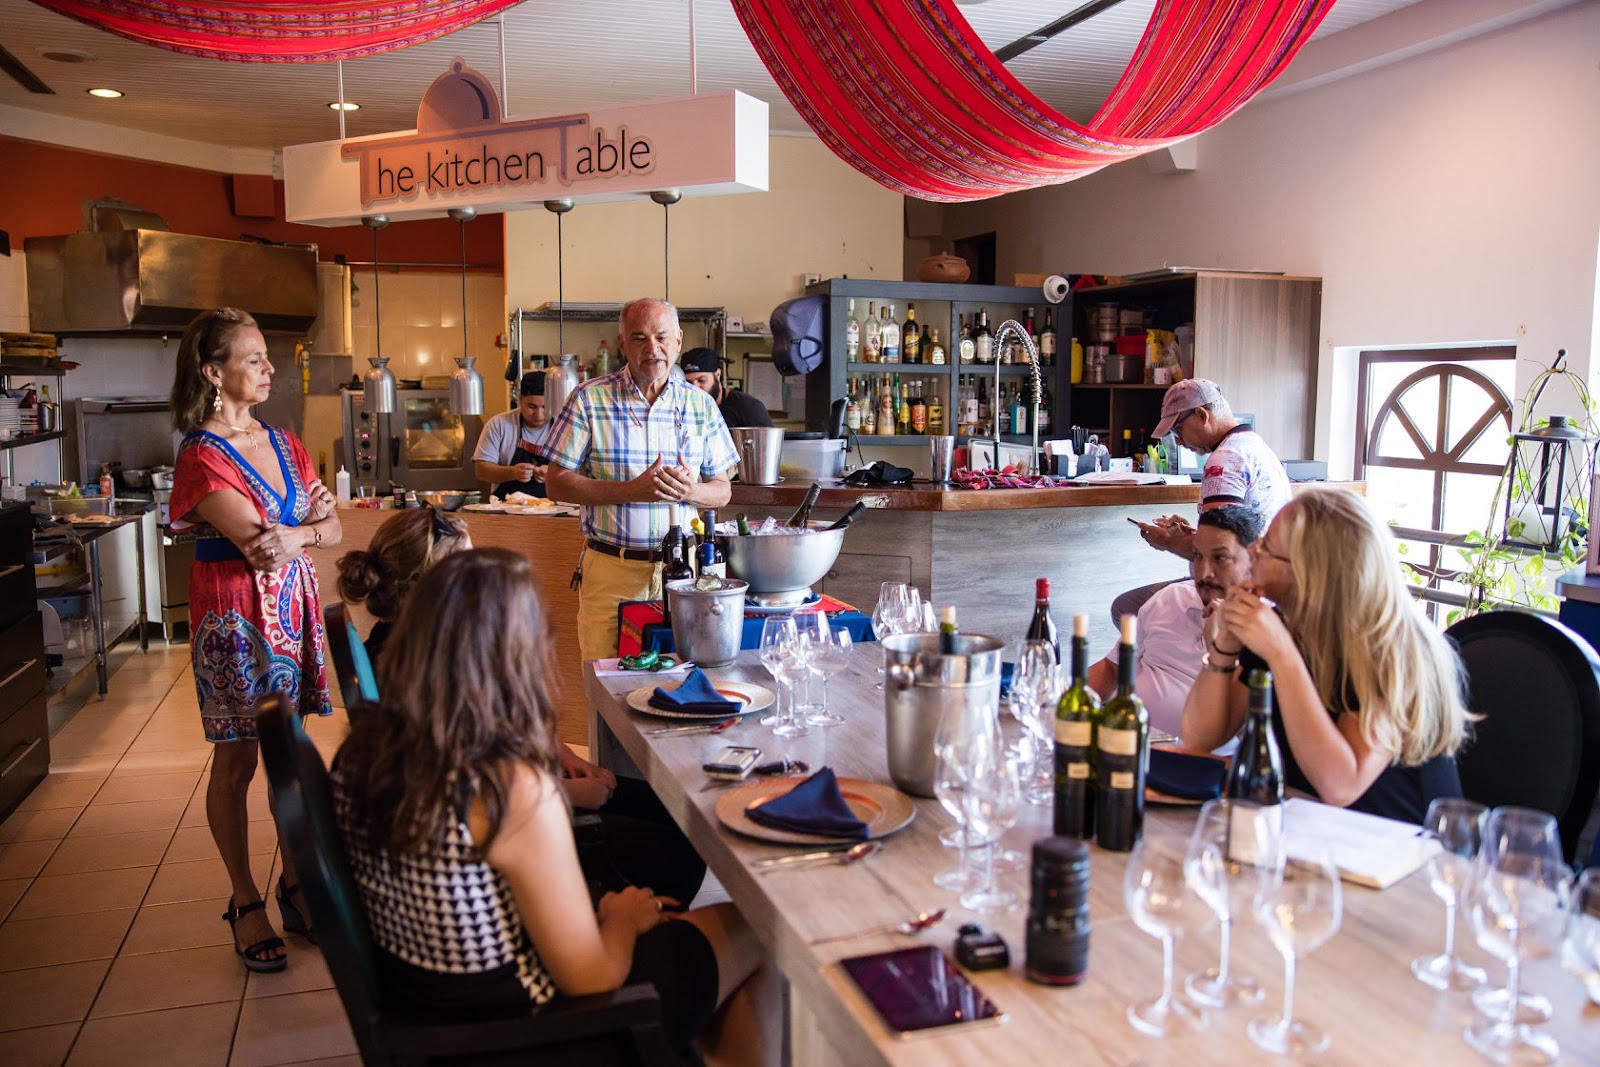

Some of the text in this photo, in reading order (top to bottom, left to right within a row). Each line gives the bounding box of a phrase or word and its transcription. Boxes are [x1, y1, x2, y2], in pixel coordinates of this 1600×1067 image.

[347, 119, 650, 204] The kitchen Table
